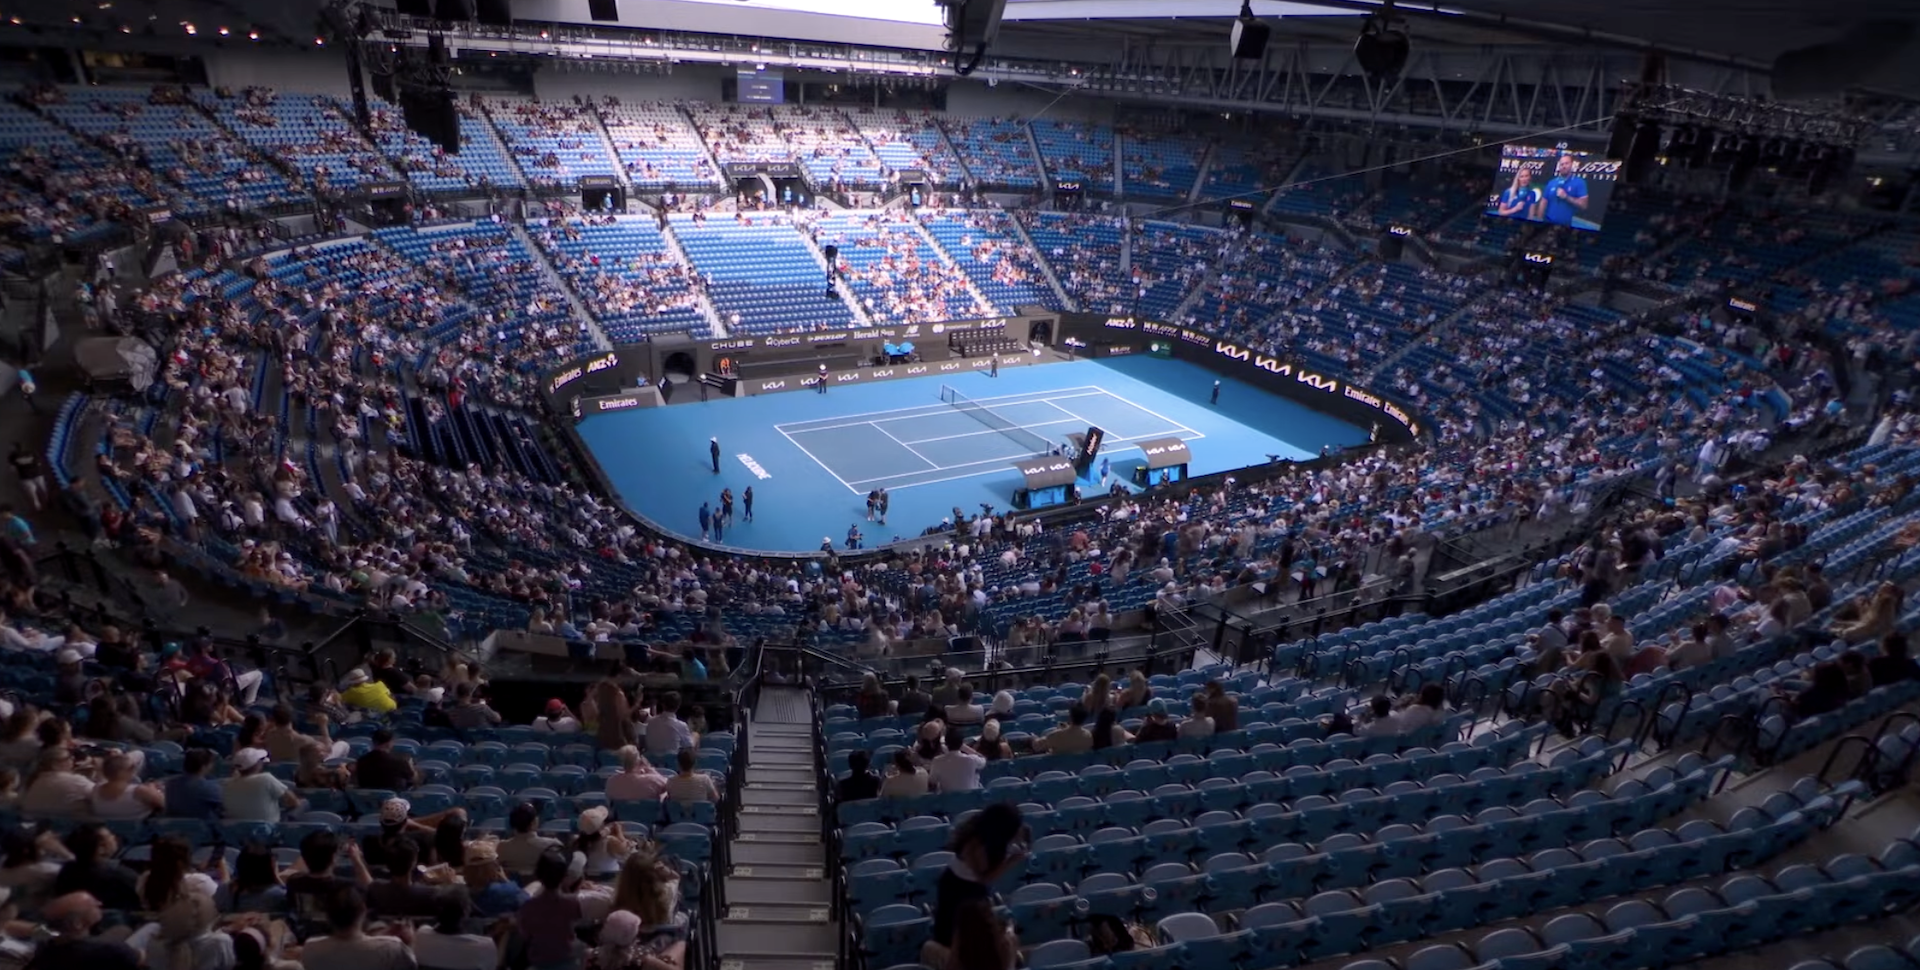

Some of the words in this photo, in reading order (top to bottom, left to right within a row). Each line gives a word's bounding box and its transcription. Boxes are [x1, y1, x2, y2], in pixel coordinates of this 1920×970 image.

[1579, 160, 1623, 173] 1573
[1058, 182, 1080, 190] KIA
[1390, 226, 1412, 236] KIA
[1525, 252, 1552, 264] KIA
[853, 329, 879, 340] Herald
[880, 328, 895, 338] Sun
[980, 319, 1006, 328] KIA
[762, 380, 785, 390] KIA
[837, 373, 859, 382] KIA
[873, 369, 894, 378] KIA
[907, 366, 927, 375] KIA
[940, 362, 960, 371] KIA
[972, 359, 991, 368] KIA
[1002, 356, 1021, 365] KIA
[1216, 341, 1249, 362] KIA
[1254, 355, 1291, 376] KIA
[1297, 370, 1337, 393] KIA
[1344, 386, 1381, 409] Emirates
[599, 398, 638, 410] Emirates
[1146, 447, 1165, 455] KIA
[1167, 443, 1186, 452] KIA
[1024, 467, 1046, 476] KIA
[1050, 462, 1070, 472] KIA
